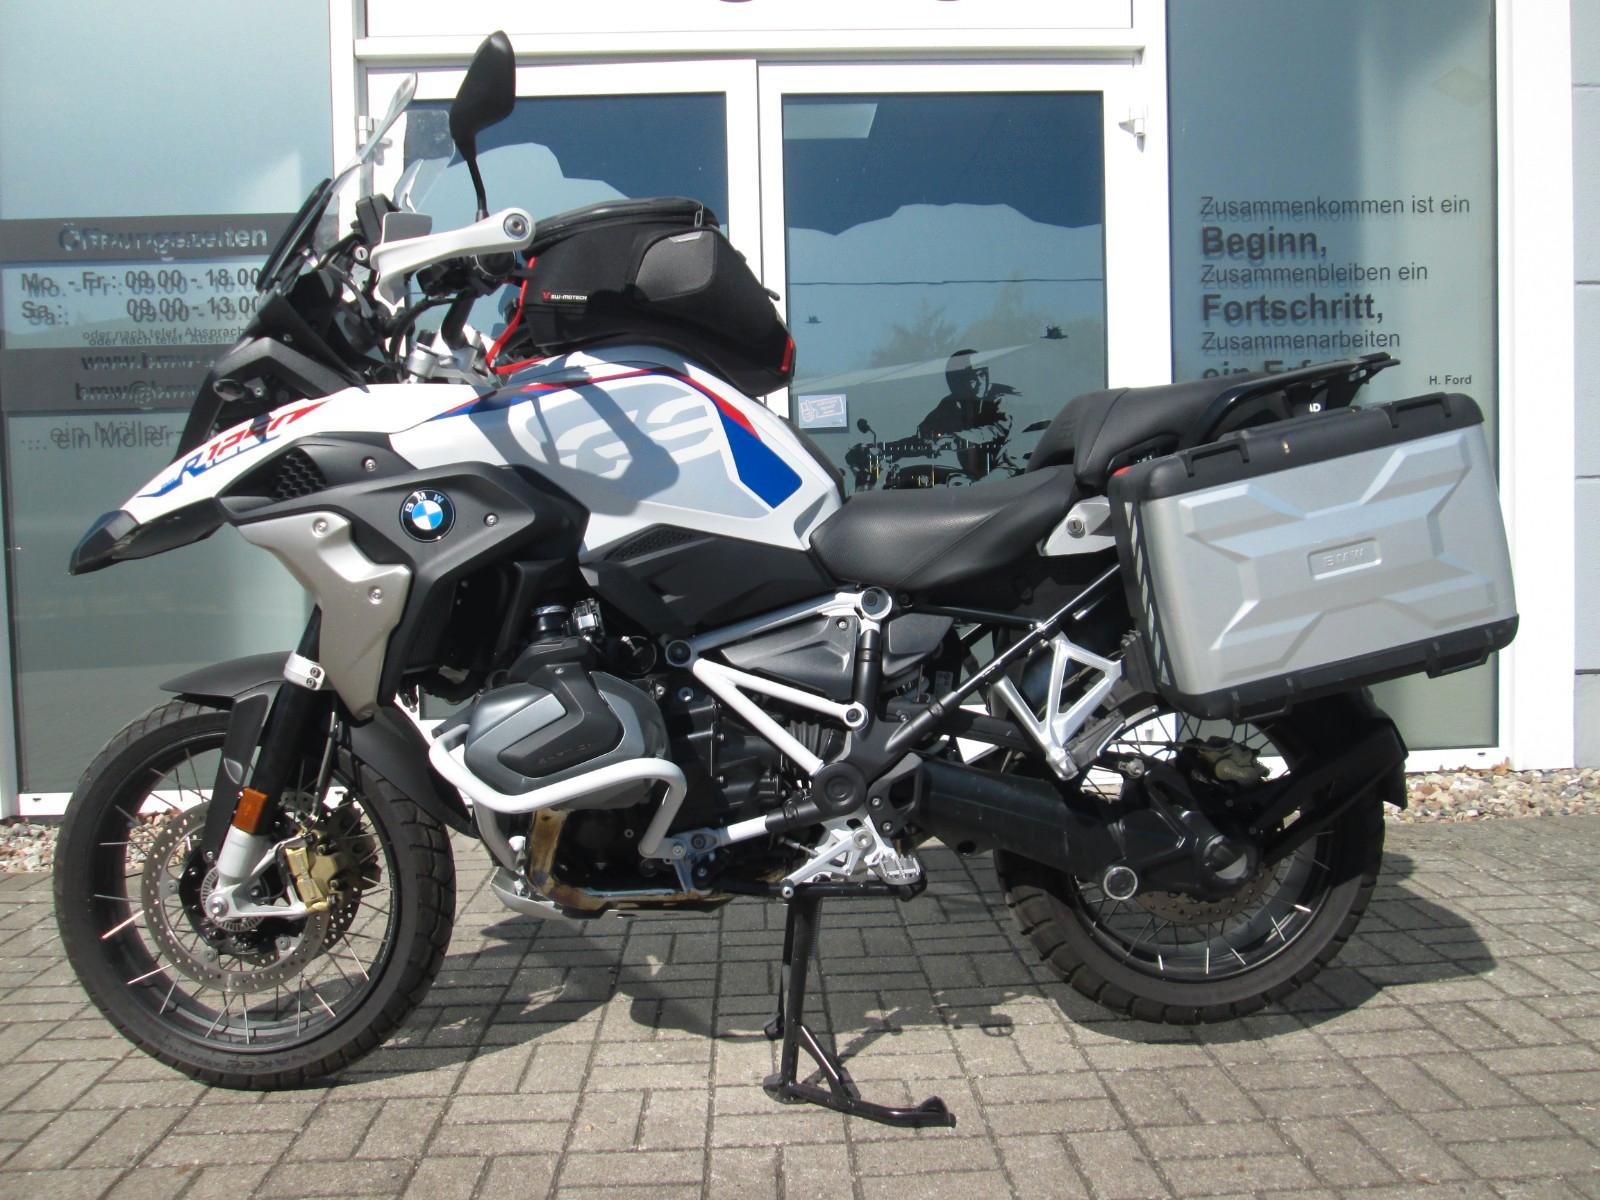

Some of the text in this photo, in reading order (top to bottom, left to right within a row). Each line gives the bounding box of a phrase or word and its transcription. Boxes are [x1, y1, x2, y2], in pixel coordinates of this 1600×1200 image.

[1200, 194, 1471, 216] Zusammenkommen ist ein
[1202, 226, 1328, 261] Beginn,
[1200, 262, 1428, 284] Zusammenbleiben ein
[1202, 293, 1384, 323] Fortschritt,
[1200, 330, 1400, 351] Zusammenarbeiten
[1428, 374, 1473, 386] H. Ford
[404, 491, 445, 513] BMW
